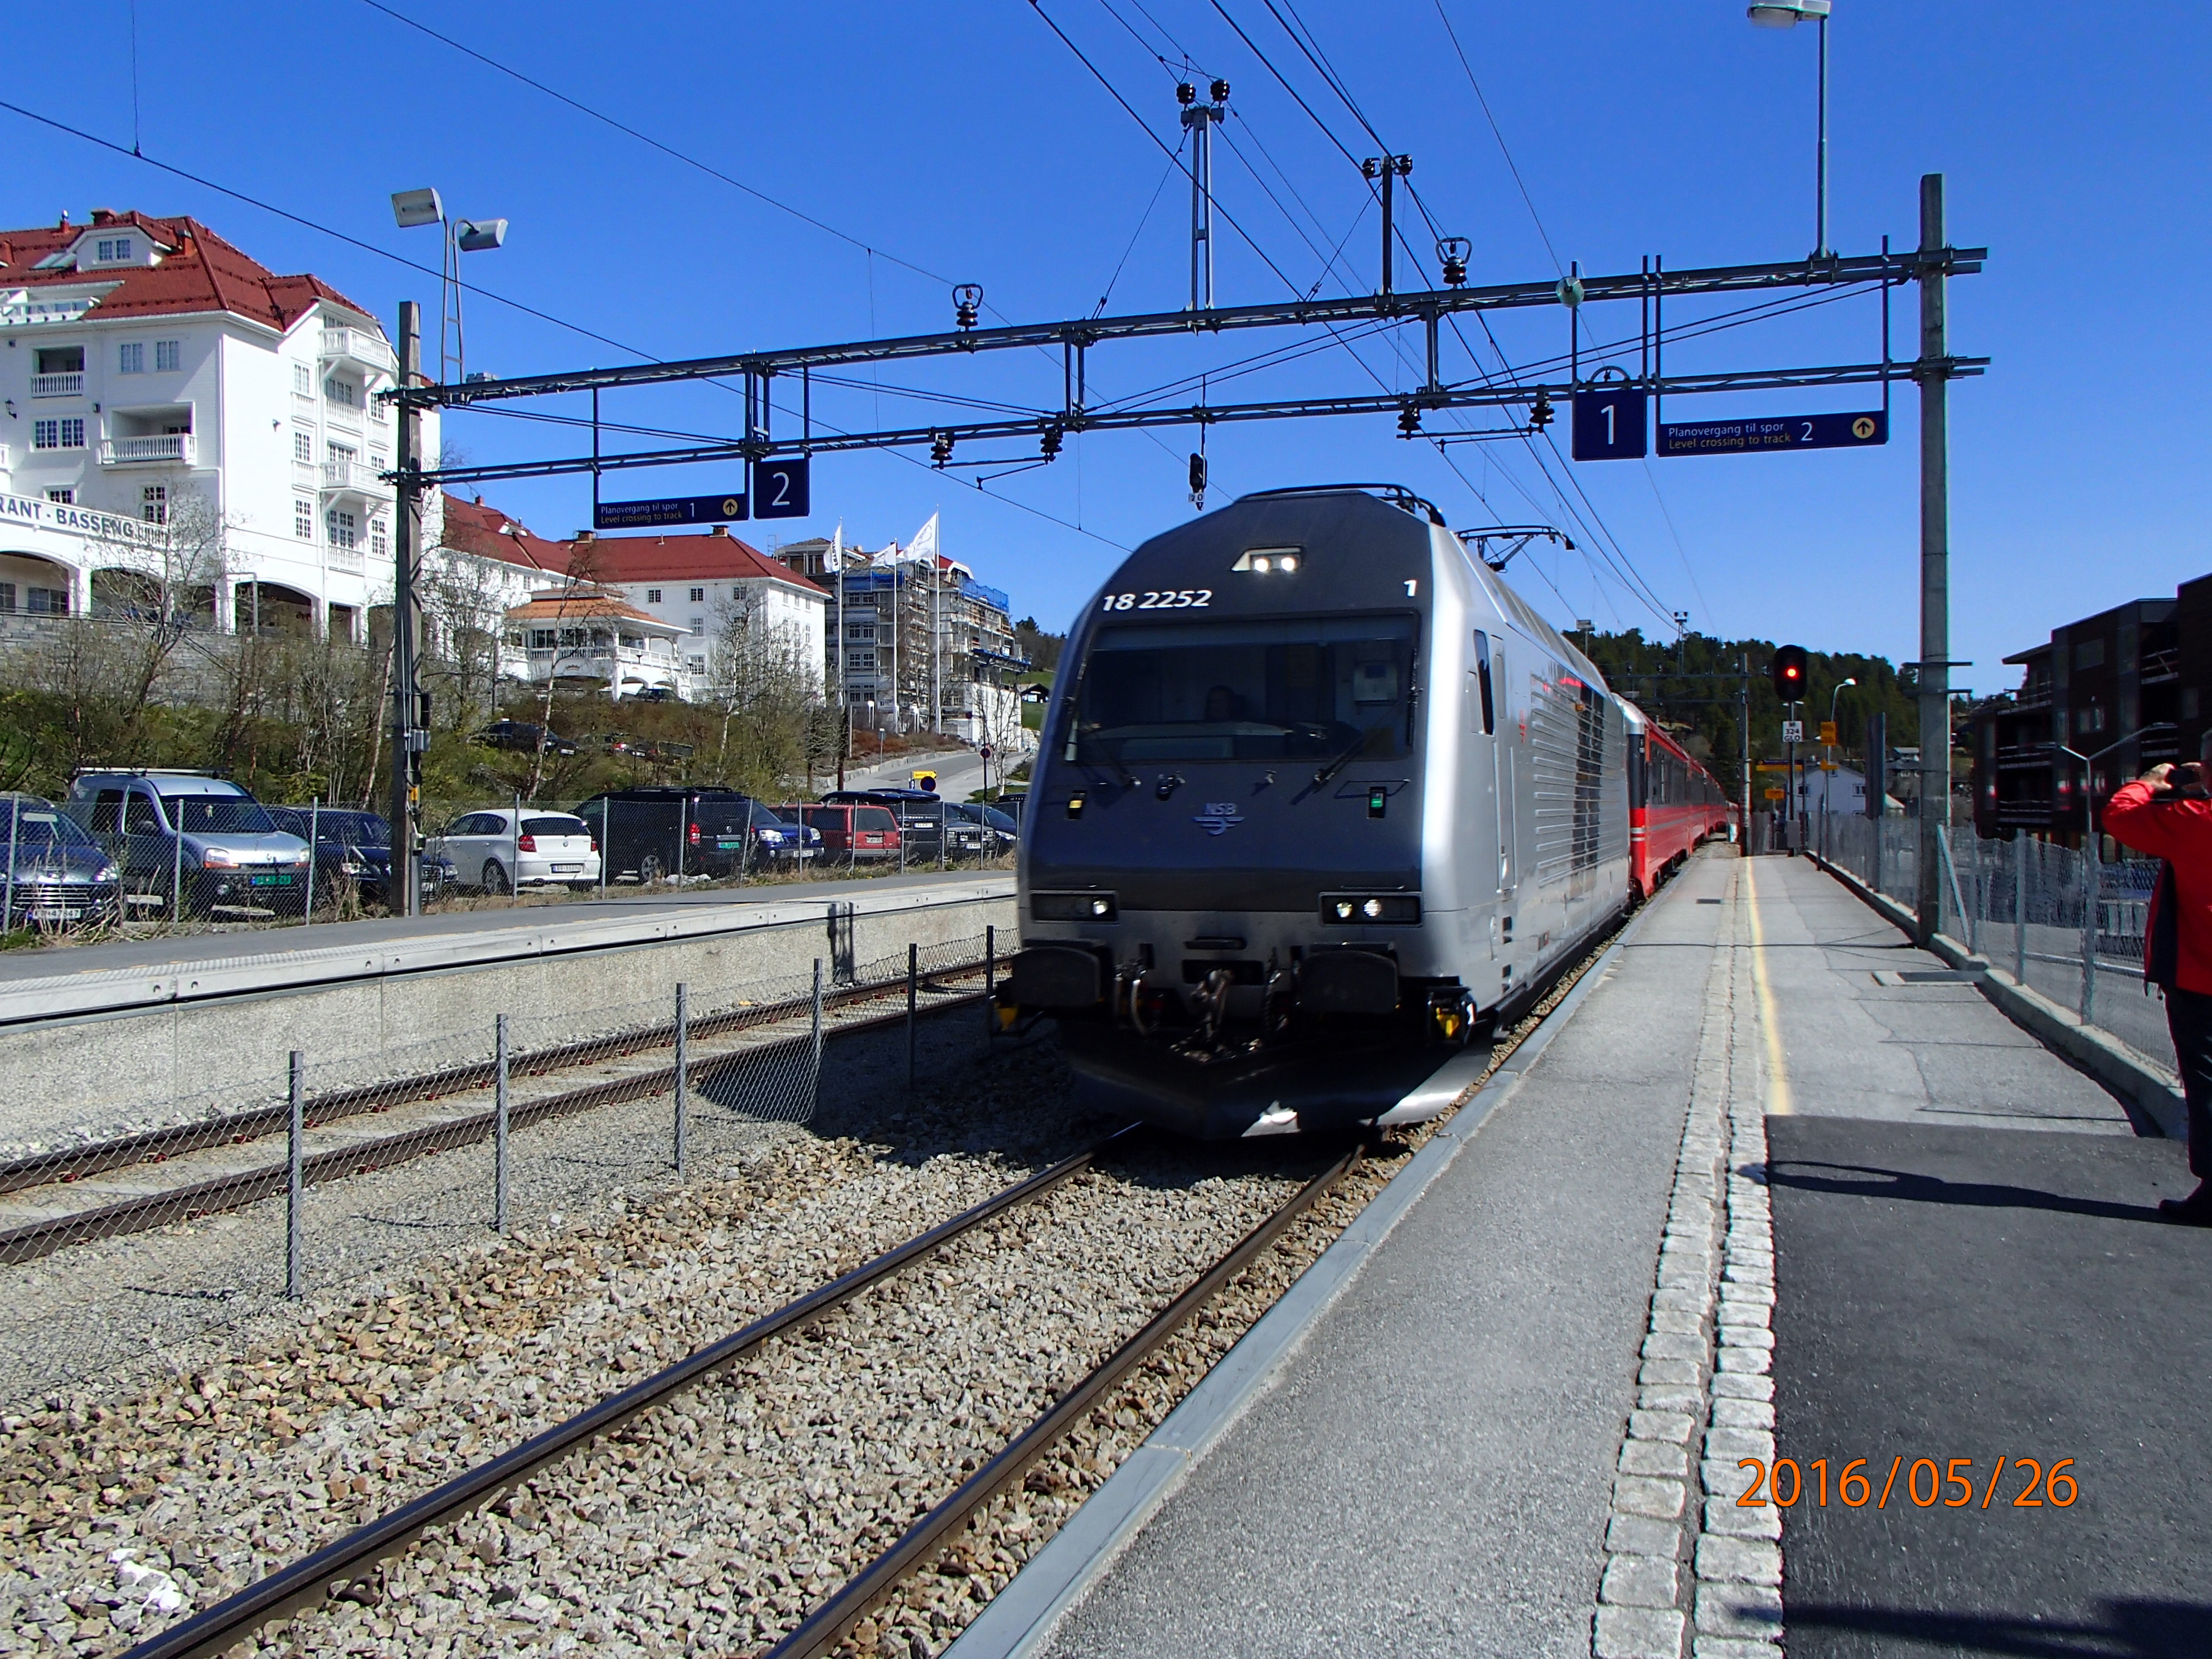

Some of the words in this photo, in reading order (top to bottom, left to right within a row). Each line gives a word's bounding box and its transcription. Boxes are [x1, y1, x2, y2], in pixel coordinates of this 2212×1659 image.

[1600, 405, 1614, 445] 1
[1668, 425, 1741, 437] Planovergang
[1745, 423, 1756, 433] til
[1760, 423, 1784, 433] spor
[1800, 421, 1813, 442] 2
[1668, 438, 1696, 449] Level
[1700, 436, 1744, 448] crossing
[1749, 436, 1760, 444] to
[1763, 433, 1791, 444] track
[772, 472, 790, 506] 2
[601, 505, 650, 515] Planovergang
[601, 515, 620, 524] Level
[622, 513, 652, 523] crossing
[664, 511, 682, 520] track
[690, 502, 695, 518] 1
[56, 508, 134, 537] BASSENG
[1404, 580, 1417, 596] 1
[1103, 593, 1136, 611] 18
[1138, 589, 1212, 609] 2252
[1204, 803, 1236, 815] NSB
